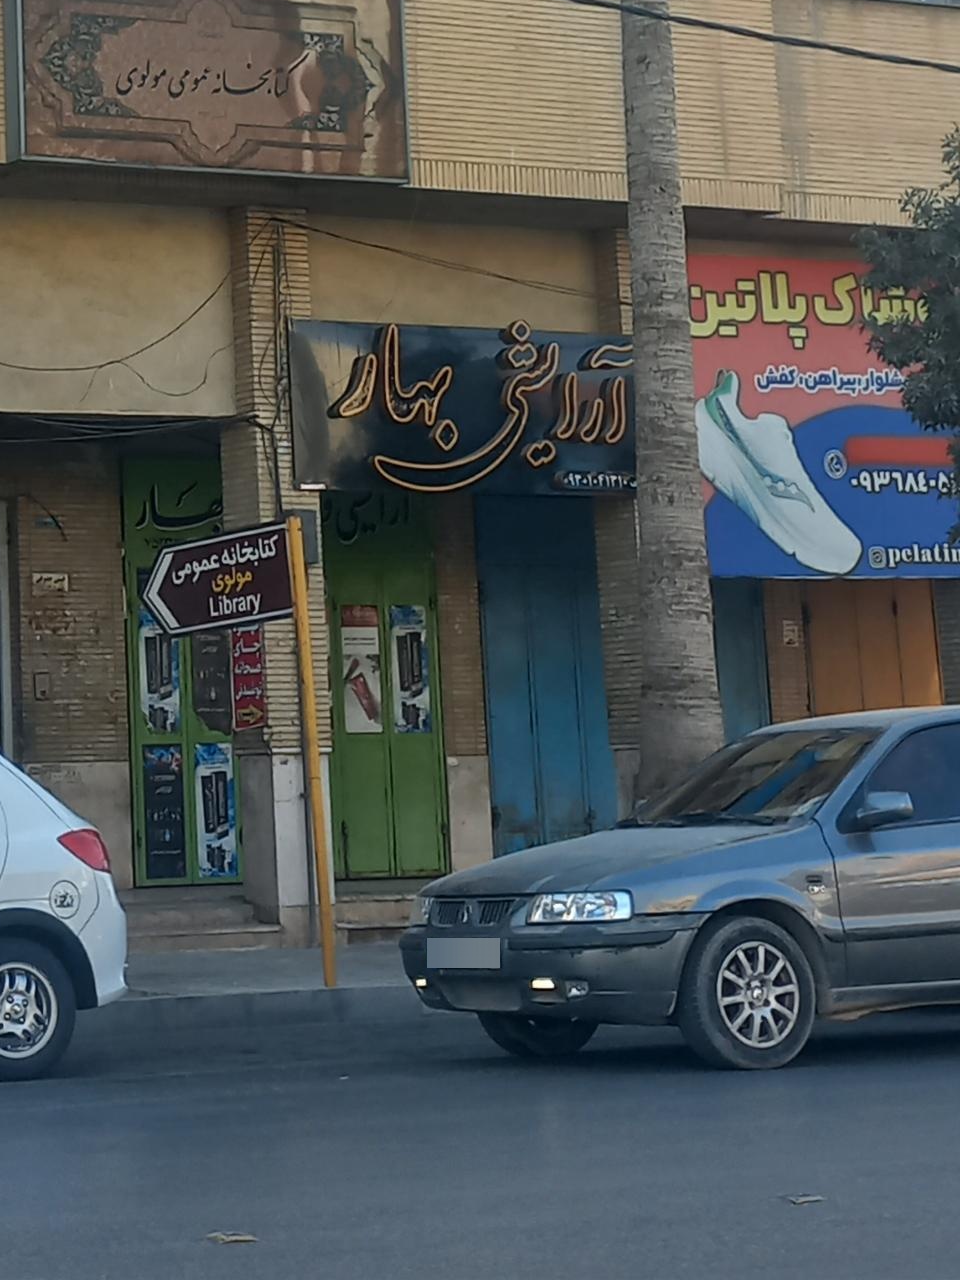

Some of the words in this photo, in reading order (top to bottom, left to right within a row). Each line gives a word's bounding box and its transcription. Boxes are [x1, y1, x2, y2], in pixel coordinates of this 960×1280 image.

[115, 57, 167, 96] مولوی
[167, 65, 211, 99] عمومی
[689, 271, 808, 350] پلاتین
[339, 323, 455, 452] بهار
[756, 366, 798, 389] کفش
[221, 534, 279, 567] کتابخانه
[171, 554, 221, 585] عمومی
[211, 566, 253, 594] مولوی
[209, 593, 261, 617] Library
